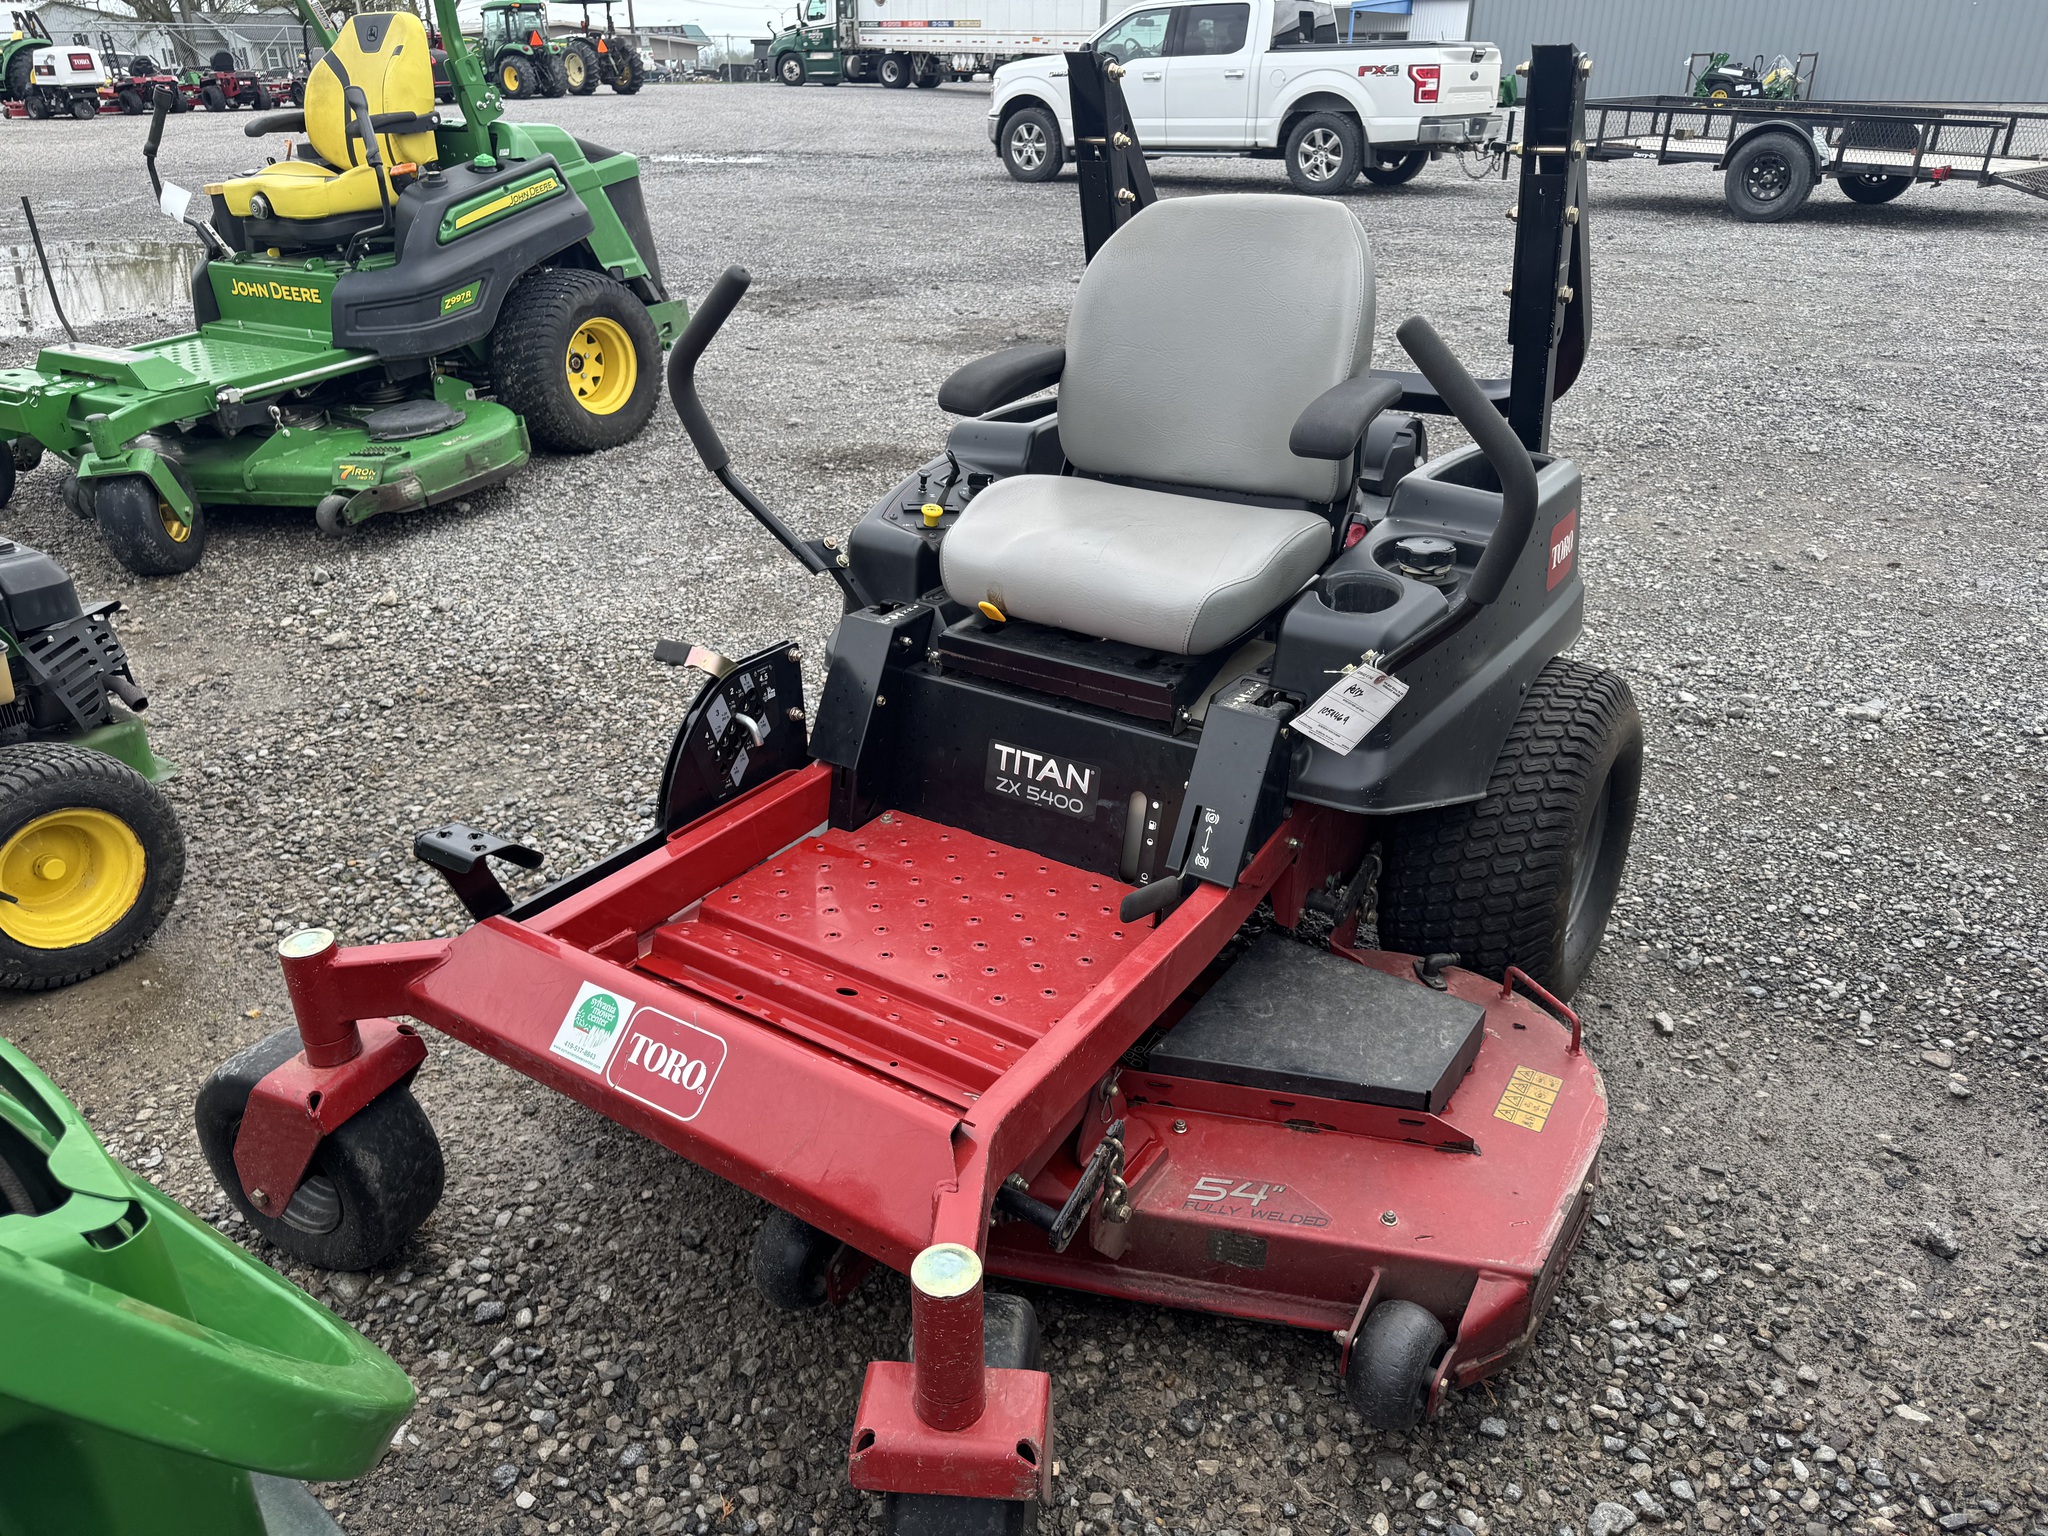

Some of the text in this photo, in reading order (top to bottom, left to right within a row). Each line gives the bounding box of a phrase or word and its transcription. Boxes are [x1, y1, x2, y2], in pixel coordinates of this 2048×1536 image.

[1358, 65, 1399, 77] FX4
[510, 181, 553, 205] JOHN DEERE
[231, 278, 322, 304] JOHN DEERE
[444, 290, 472, 309] Z997R
[1551, 530, 1574, 570] TORO
[994, 743, 1090, 794] TITAN
[995, 776, 1084, 813] ZX 5400
[590, 997, 617, 1014] sylvania
[592, 1007, 616, 1022] mower
[587, 1013, 609, 1027] center
[628, 1032, 707, 1091] TORO
[1187, 1176, 1287, 1207] 54"
[1182, 1200, 1329, 1227] FULLY WELDED
